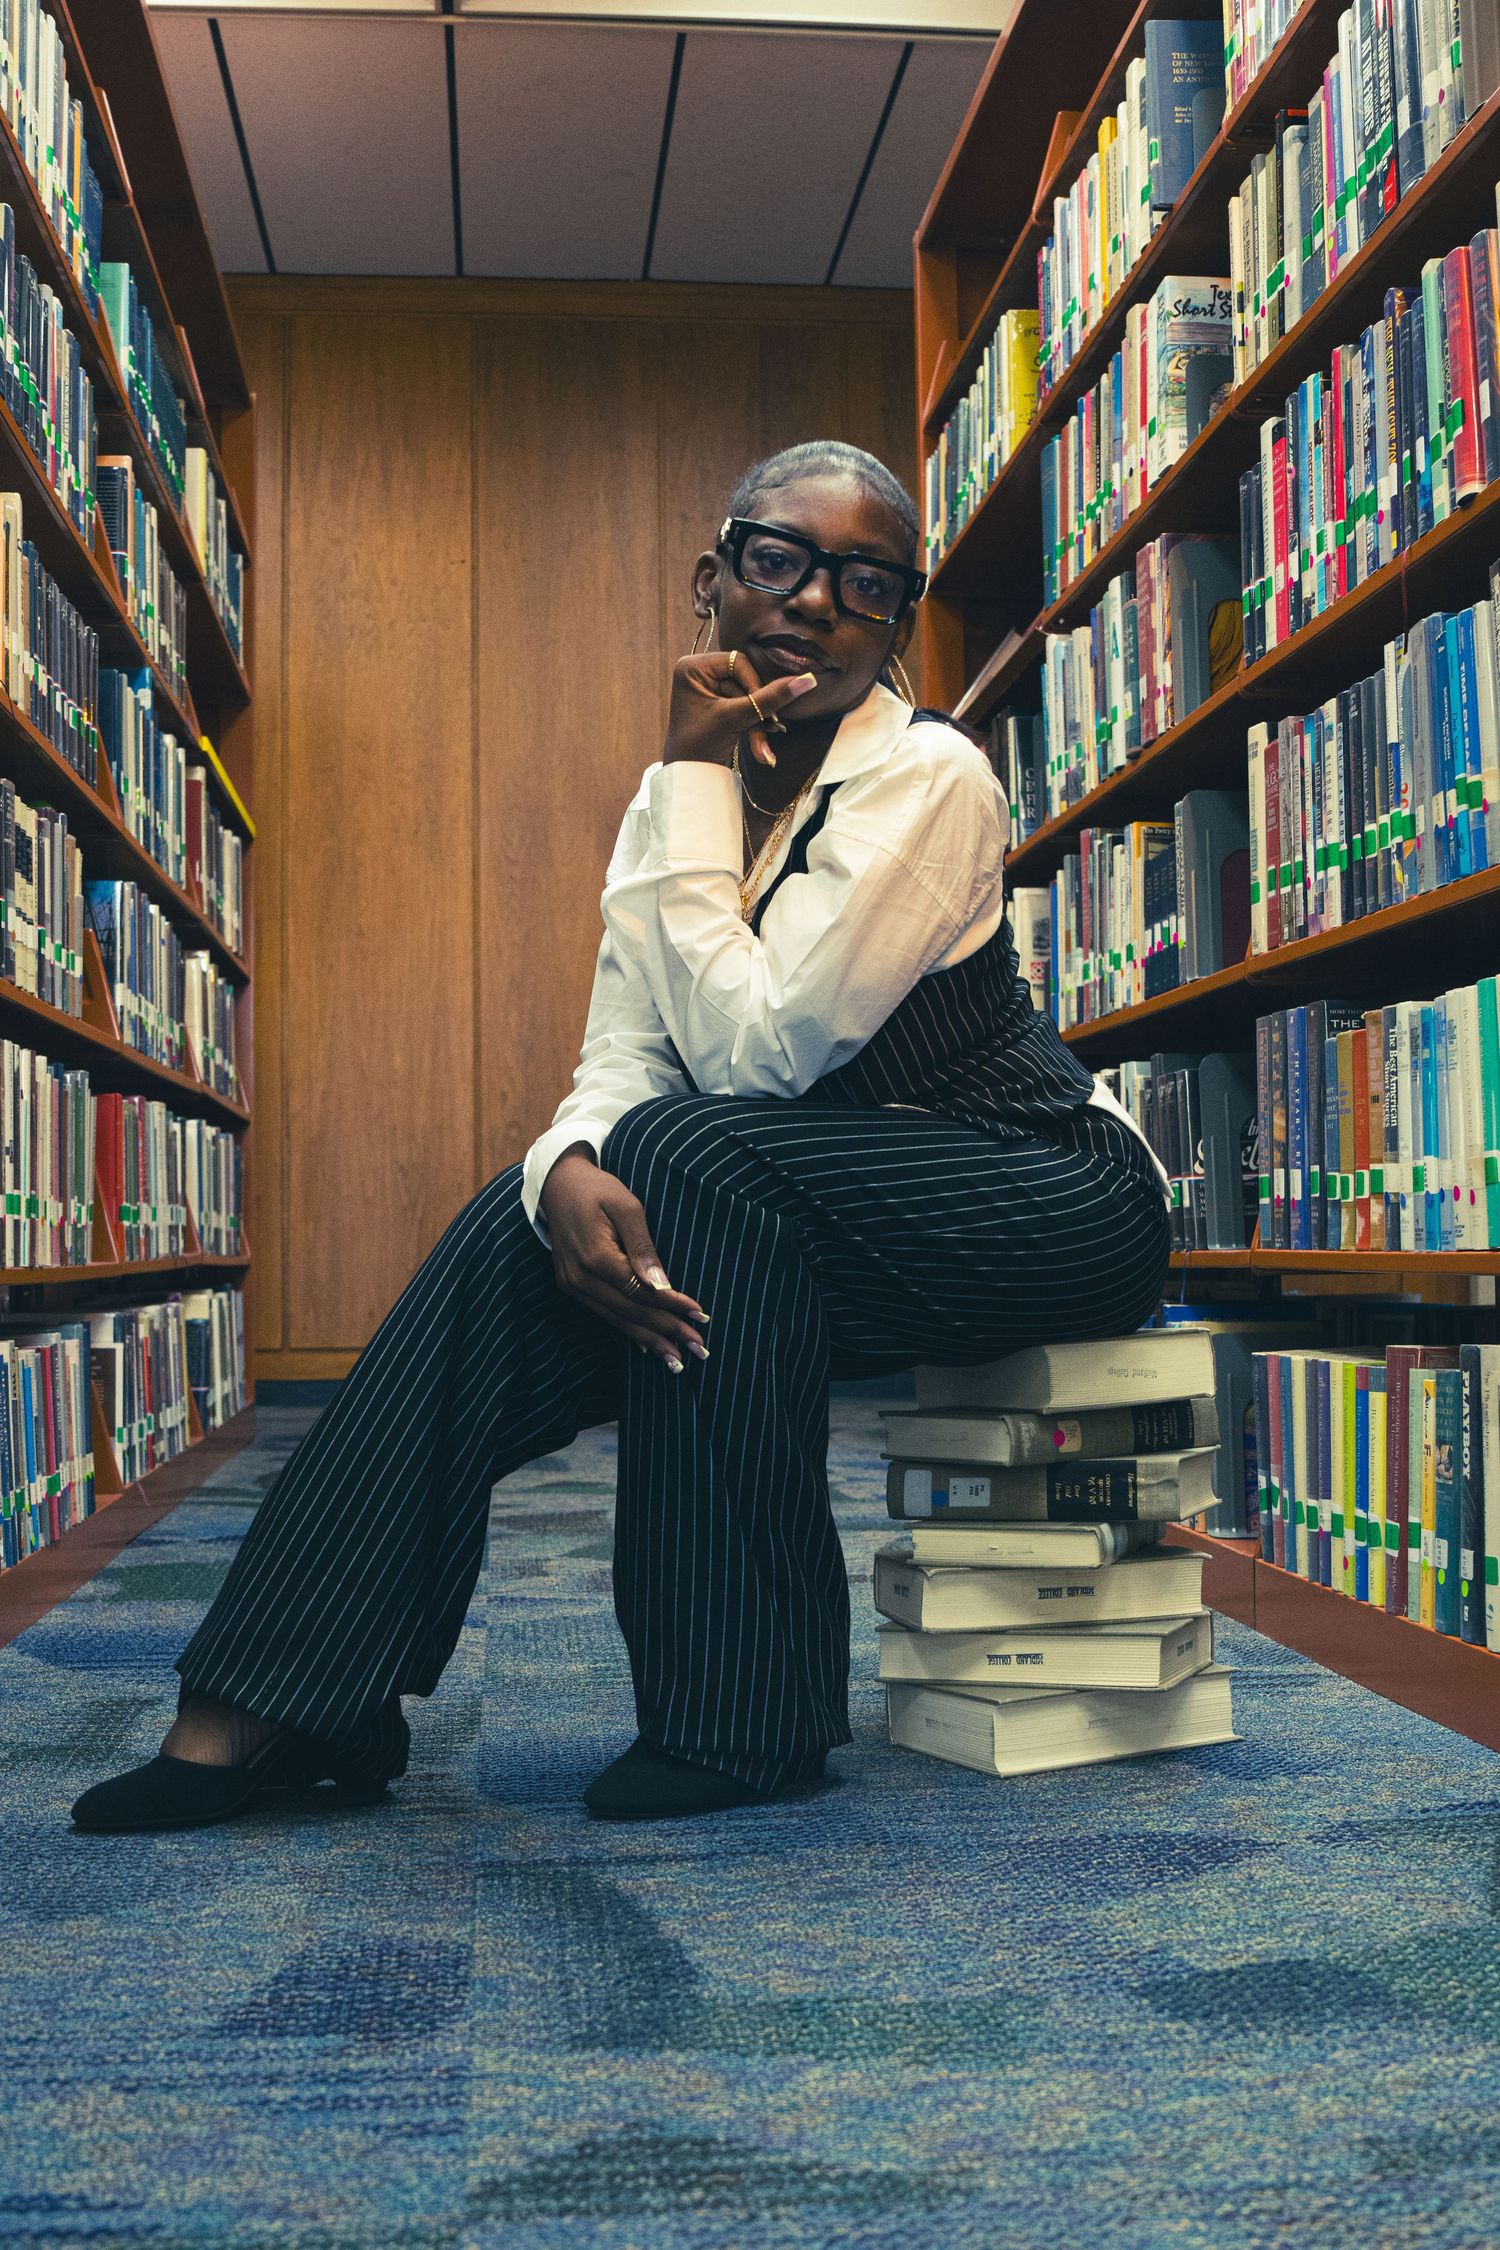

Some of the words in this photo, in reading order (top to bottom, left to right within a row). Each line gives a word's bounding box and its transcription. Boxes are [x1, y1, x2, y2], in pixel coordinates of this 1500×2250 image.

[1363, 82, 1374, 136] FIGHTS
[1173, 298, 1216, 318] Short
[1386, 346, 1394, 375] NEW
[1387, 378, 1396, 440] TWILIGHT
[1462, 709, 1468, 734] OF
[1331, 1019, 1361, 1028] THE
[1389, 1026, 1397, 1047] The
[1462, 1370, 1470, 1480] PLAYBOY
[1037, 1587, 1063, 1600] COLLEGE
[1066, 1585, 1094, 1597] MIDLAND
[986, 1654, 1012, 1666] COLLEGE
[1015, 1652, 1044, 1666] MIDLAND
